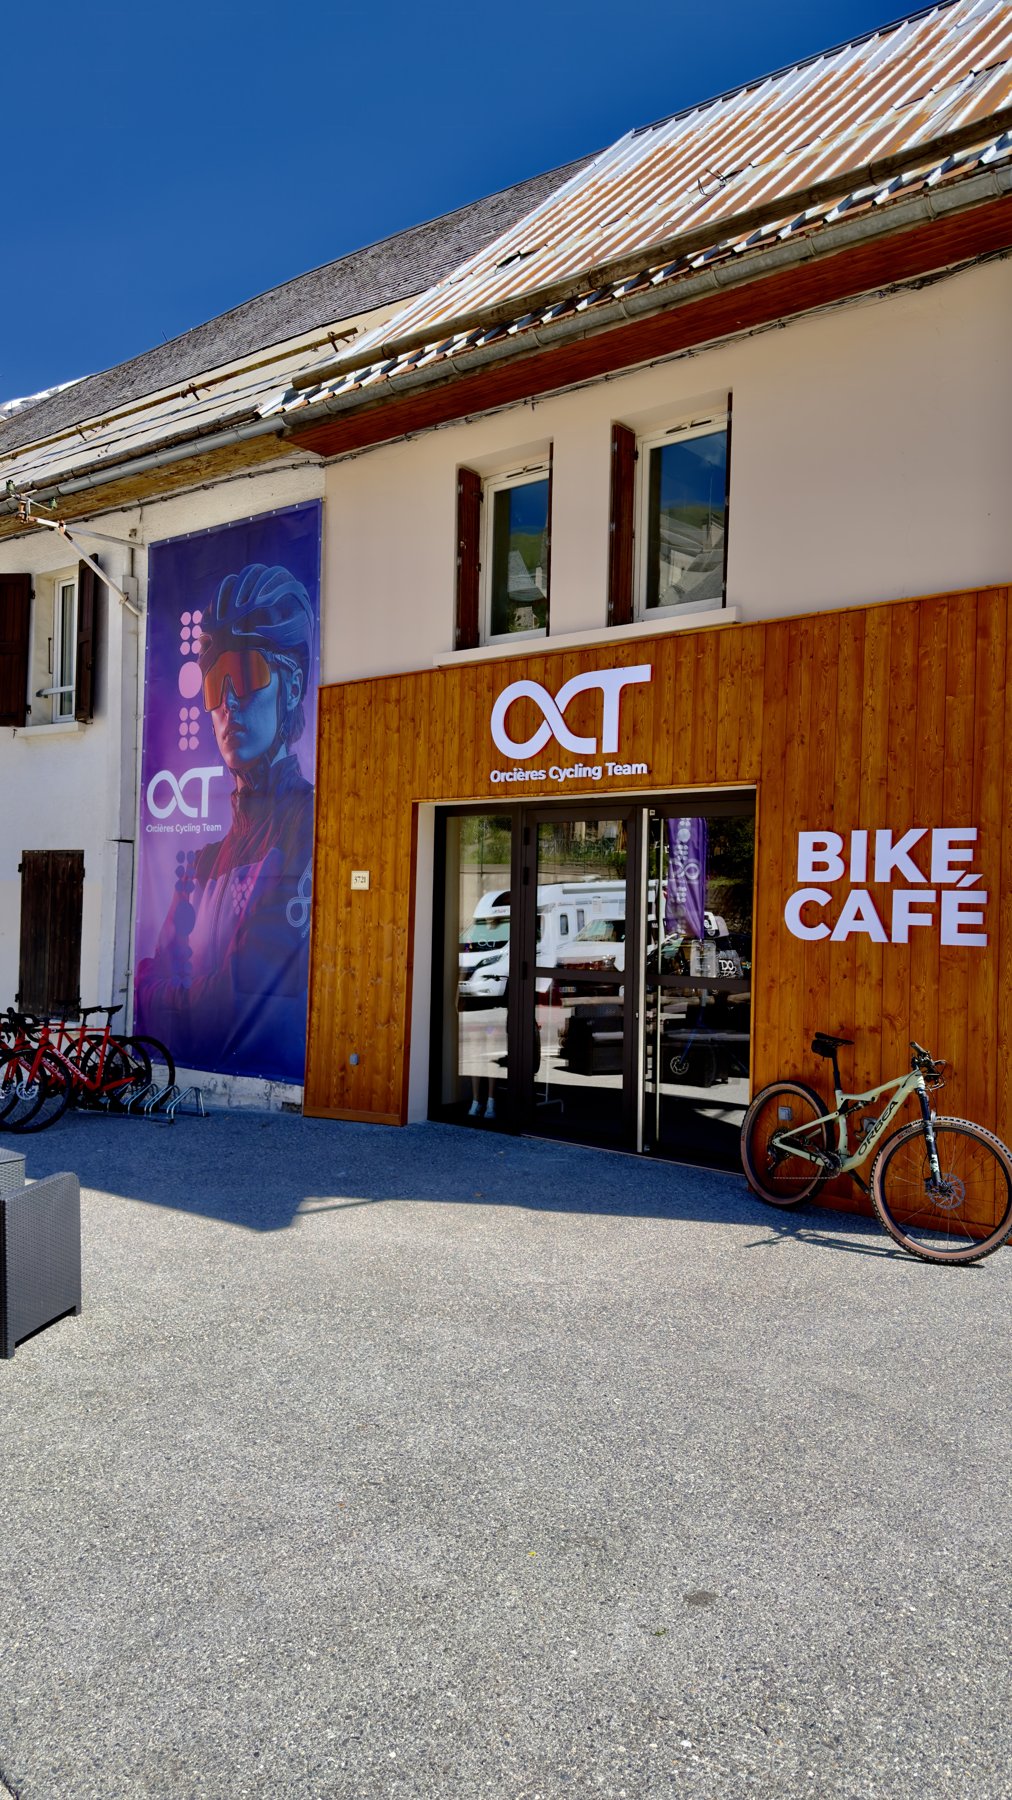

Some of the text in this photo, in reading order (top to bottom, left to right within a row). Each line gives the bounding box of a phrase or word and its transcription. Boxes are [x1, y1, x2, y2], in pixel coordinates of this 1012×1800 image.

[490, 664, 651, 760] OCT
[146, 766, 223, 819] OCT
[490, 762, 648, 782] Orcières Cycling Team
[146, 823, 222, 834] Orcières Cycling Team
[797, 828, 977, 883] BIKE
[784, 874, 988, 947] CAFÉ
[858, 1100, 899, 1156] ORBEA
